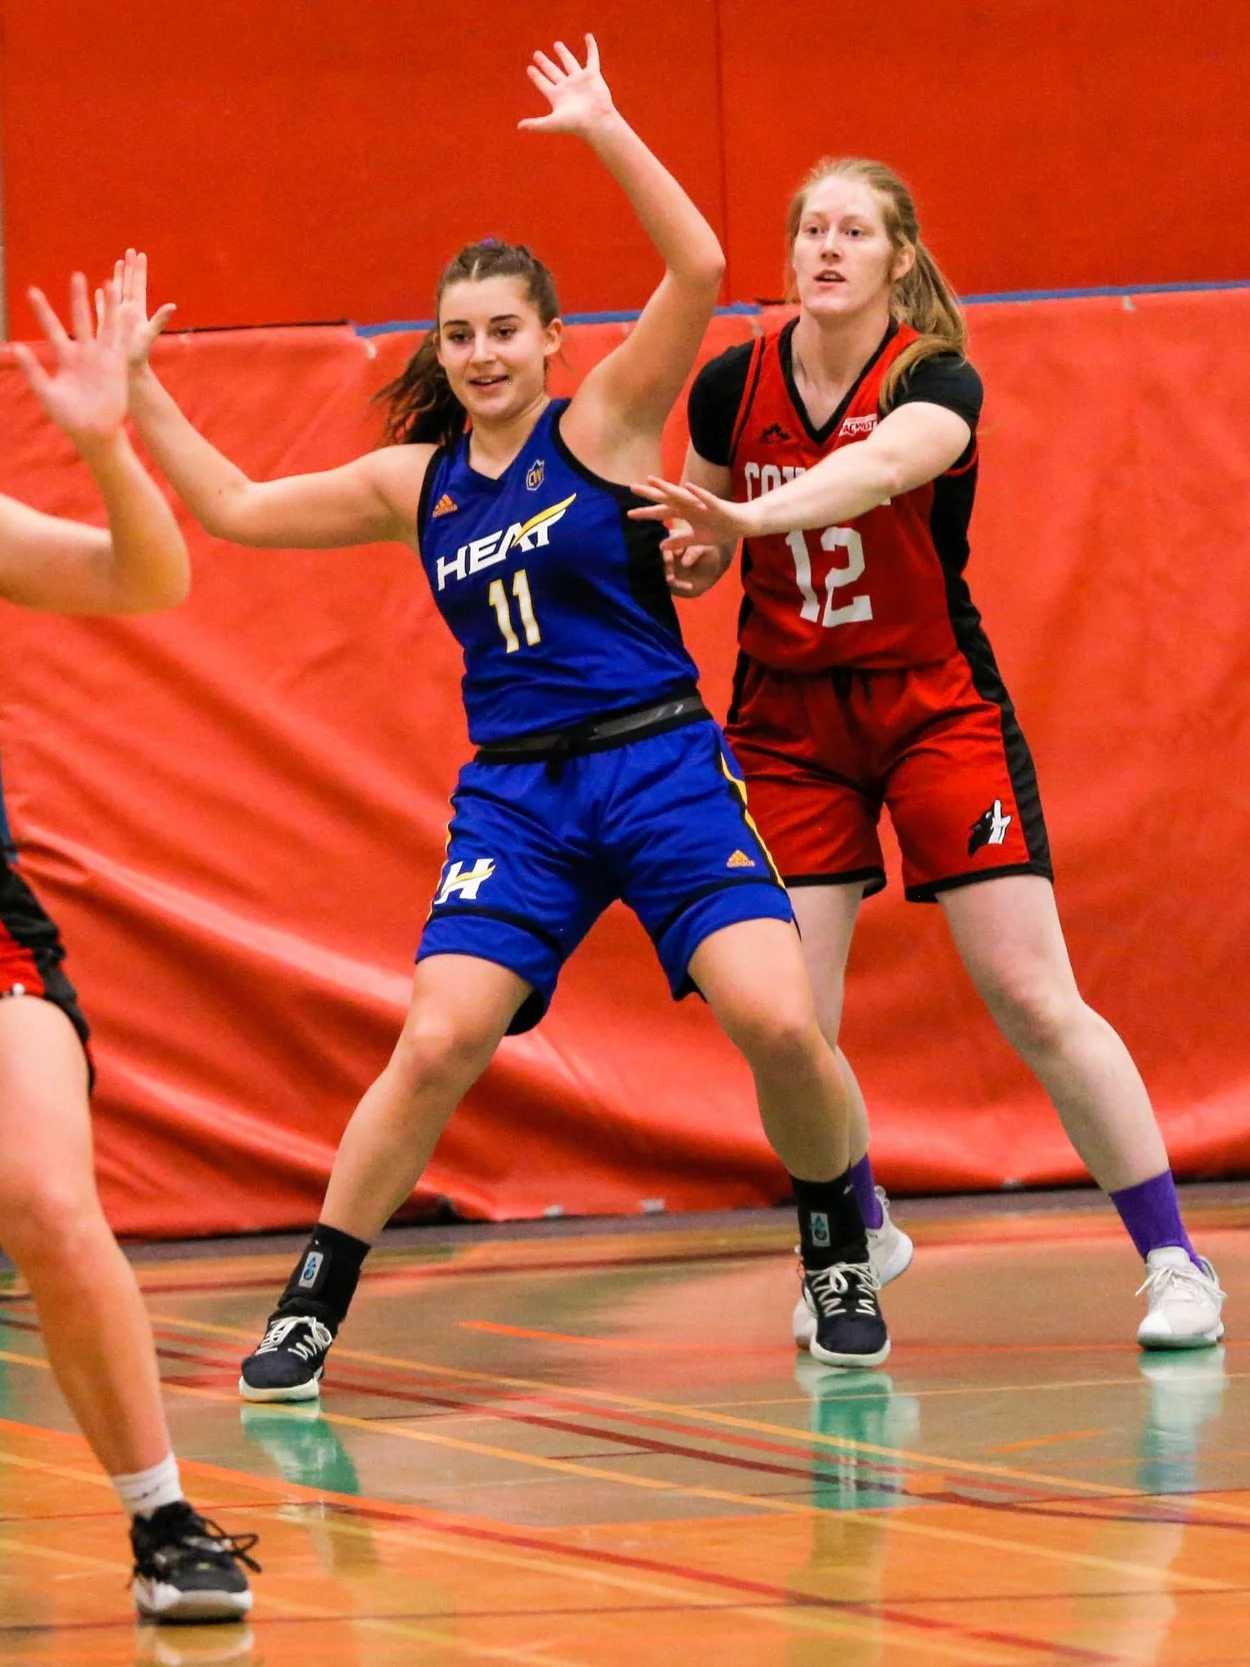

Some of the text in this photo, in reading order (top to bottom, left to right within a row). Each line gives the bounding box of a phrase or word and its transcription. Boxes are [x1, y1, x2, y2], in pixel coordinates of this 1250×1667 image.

[436, 492, 577, 592] HEAT
[785, 526, 873, 628] 12
[488, 568, 542, 654] 11
